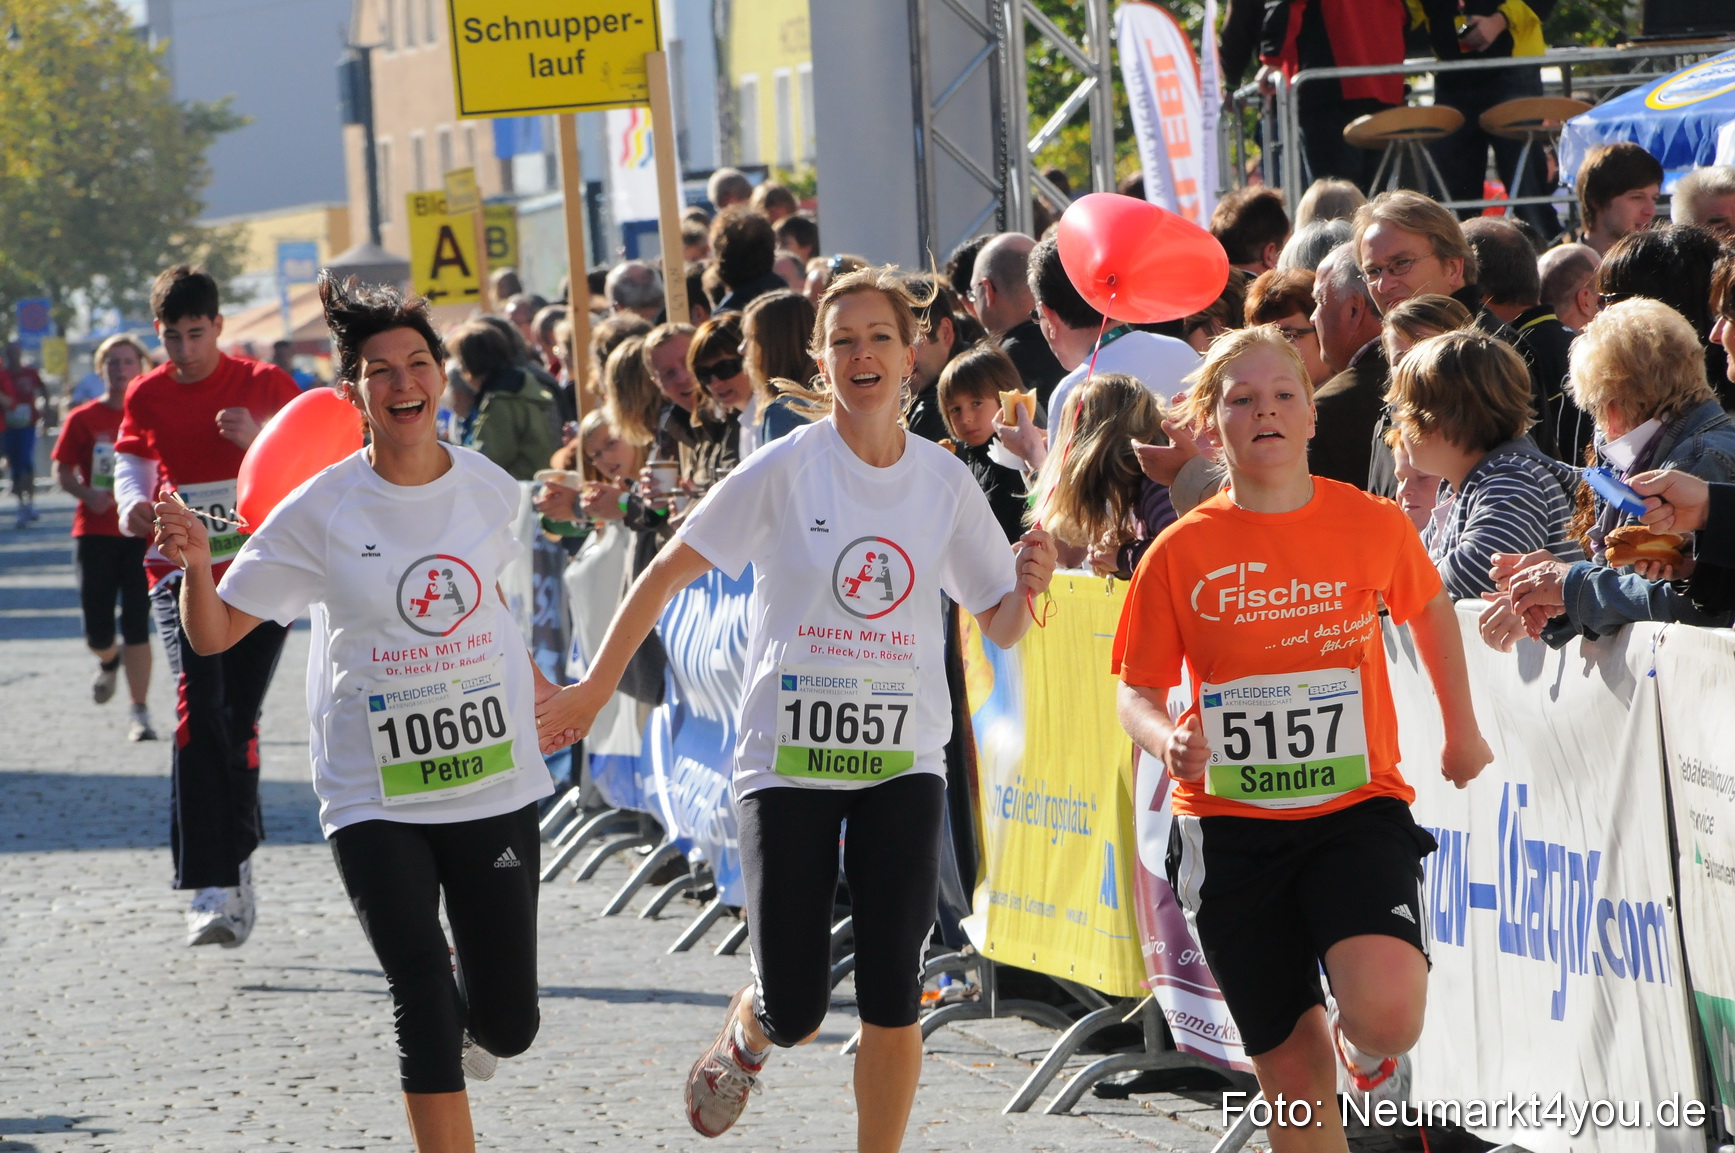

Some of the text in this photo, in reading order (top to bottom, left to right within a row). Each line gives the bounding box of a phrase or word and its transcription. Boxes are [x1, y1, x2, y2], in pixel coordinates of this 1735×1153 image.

[464, 12, 643, 43] Schnupper-
[529, 49, 586, 78] lauf
[431, 225, 471, 280] A
[485, 226, 509, 258] B
[1219, 574, 1347, 613] Fischer
[1233, 600, 1343, 625] AUTOMOBILE
[372, 632, 493, 662] LAUFEN MIT HERZ
[798, 625, 853, 640] LAUFEN
[859, 630, 887, 643] MIT
[1281, 629, 1309, 647] und
[1313, 624, 1341, 639] das
[810, 644, 825, 654] Dr.
[827, 646, 854, 658] Heck
[863, 649, 878, 659] Dr.
[386, 667, 402, 676] Dr.
[404, 662, 432, 675] Heck
[799, 675, 858, 689] PFLEIDERER
[386, 682, 448, 703] PFLEIDERER
[388, 694, 450, 710] AKTIENGESELLSCHAFT
[799, 688, 858, 696] AKTIENGESELLSCHAFT
[1223, 681, 1347, 700] PFLEIDERER BOCK
[1224, 698, 1293, 707] AKTIENGESELLSCHAFT
[378, 696, 507, 759] 10660
[785, 699, 909, 745] 10657
[1222, 703, 1344, 761] 5157
[420, 755, 484, 785] Petra
[807, 748, 883, 775] Nicole
[1240, 763, 1336, 793] Sandra
[494, 860, 521, 868] adidas
